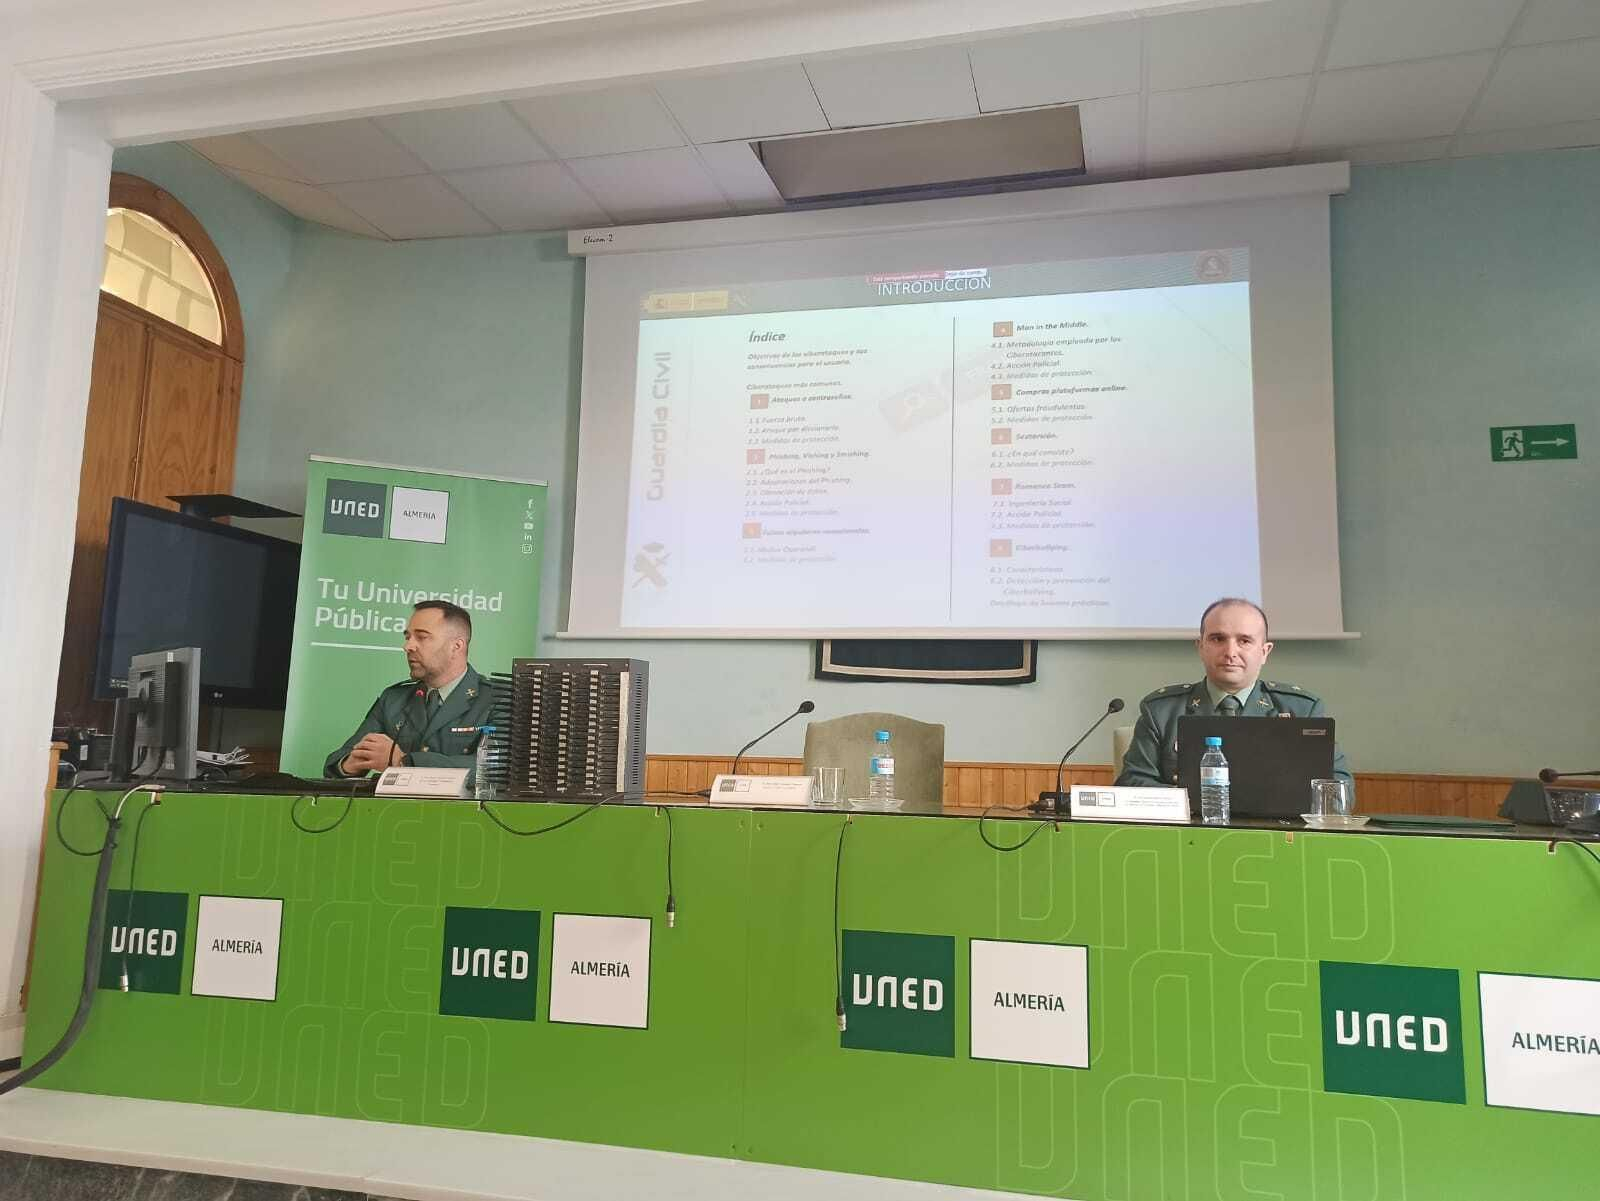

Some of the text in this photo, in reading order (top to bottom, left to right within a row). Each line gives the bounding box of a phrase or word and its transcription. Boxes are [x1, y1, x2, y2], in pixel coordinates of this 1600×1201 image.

[748, 330, 786, 343] Índice
[1017, 324, 1034, 332] Man
[1045, 321, 1058, 329] the
[331, 499, 379, 518] UNED
[318, 578, 503, 612] Tu Universidad
[110, 926, 177, 956] UNED
[212, 939, 263, 954] ALMERÍA
[451, 947, 529, 980] UNED
[570, 961, 630, 978] ALMERÍA
[853, 973, 944, 1012] UNED
[994, 991, 1065, 1012] ALMERÍA
[1335, 1010, 1448, 1053] UNED
[1511, 1031, 1600, 1055] ALMERÍA
